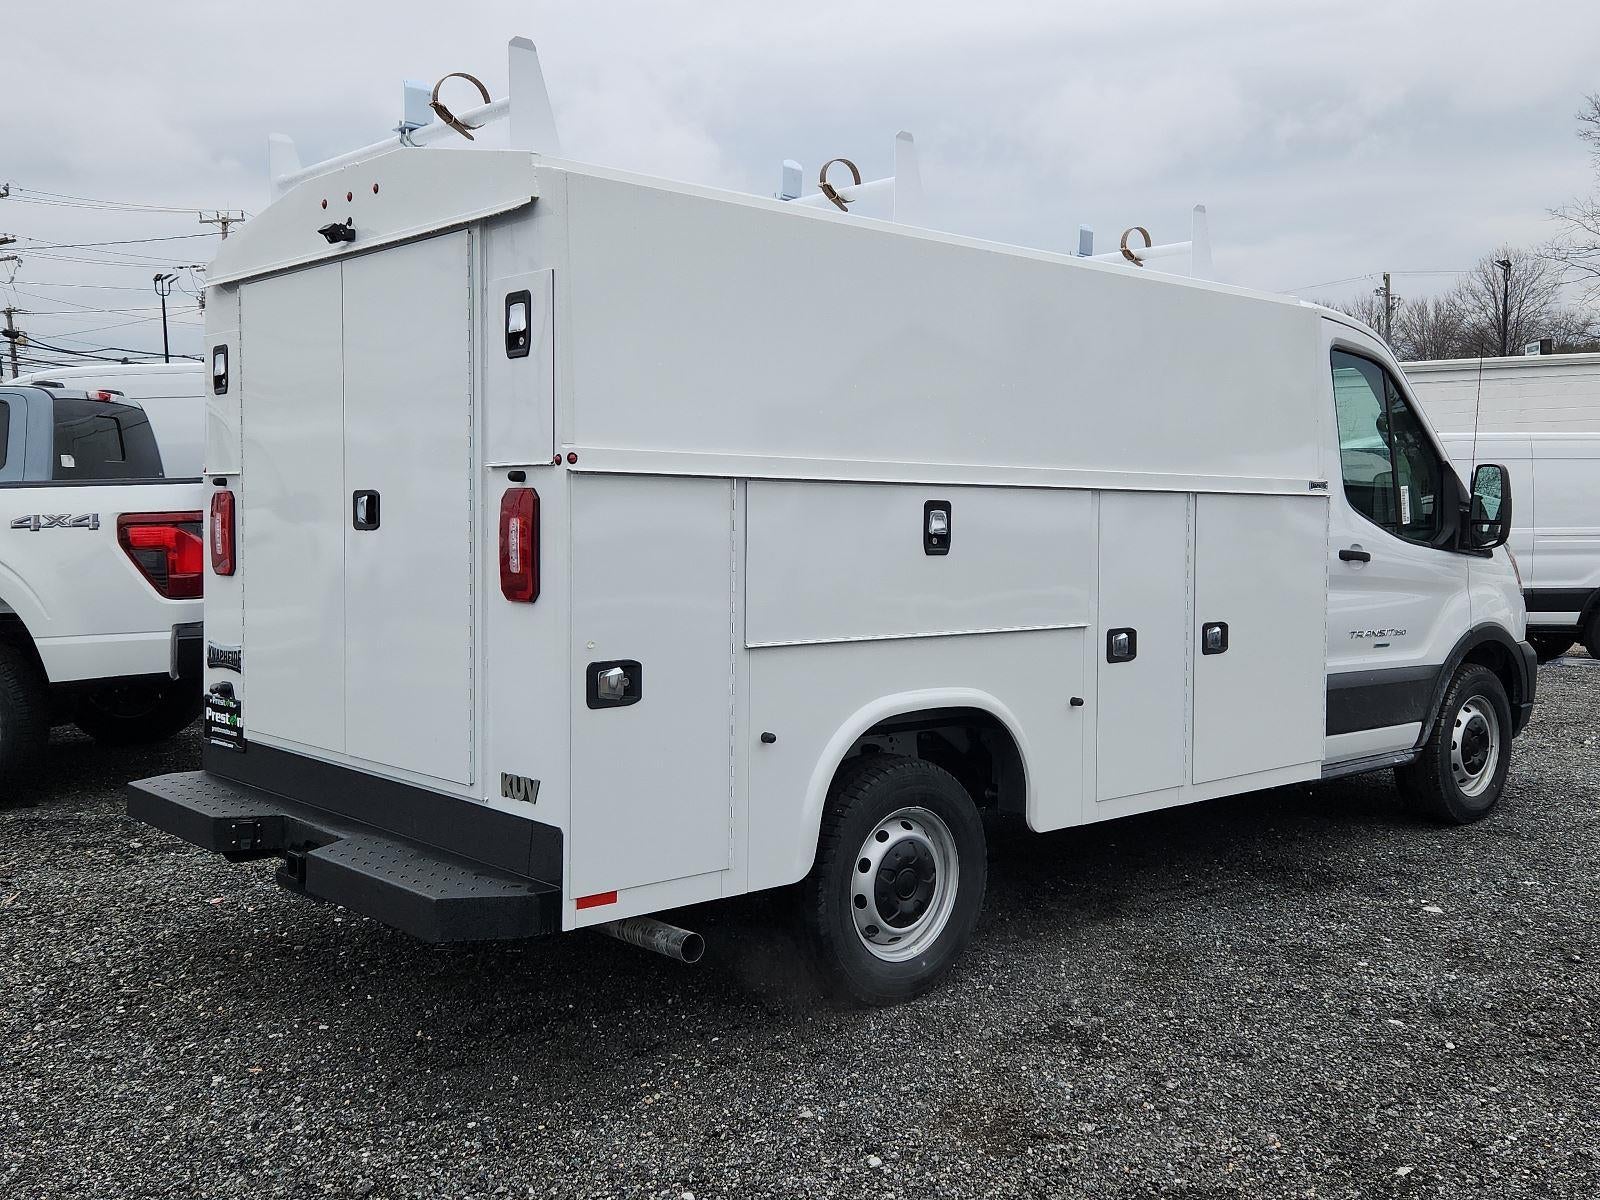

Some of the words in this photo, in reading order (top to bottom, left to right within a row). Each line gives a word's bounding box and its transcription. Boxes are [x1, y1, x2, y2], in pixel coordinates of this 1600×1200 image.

[1349, 628, 1394, 639] TRANSIT
[205, 706, 243, 728] Preston
[501, 771, 541, 805] KUV
